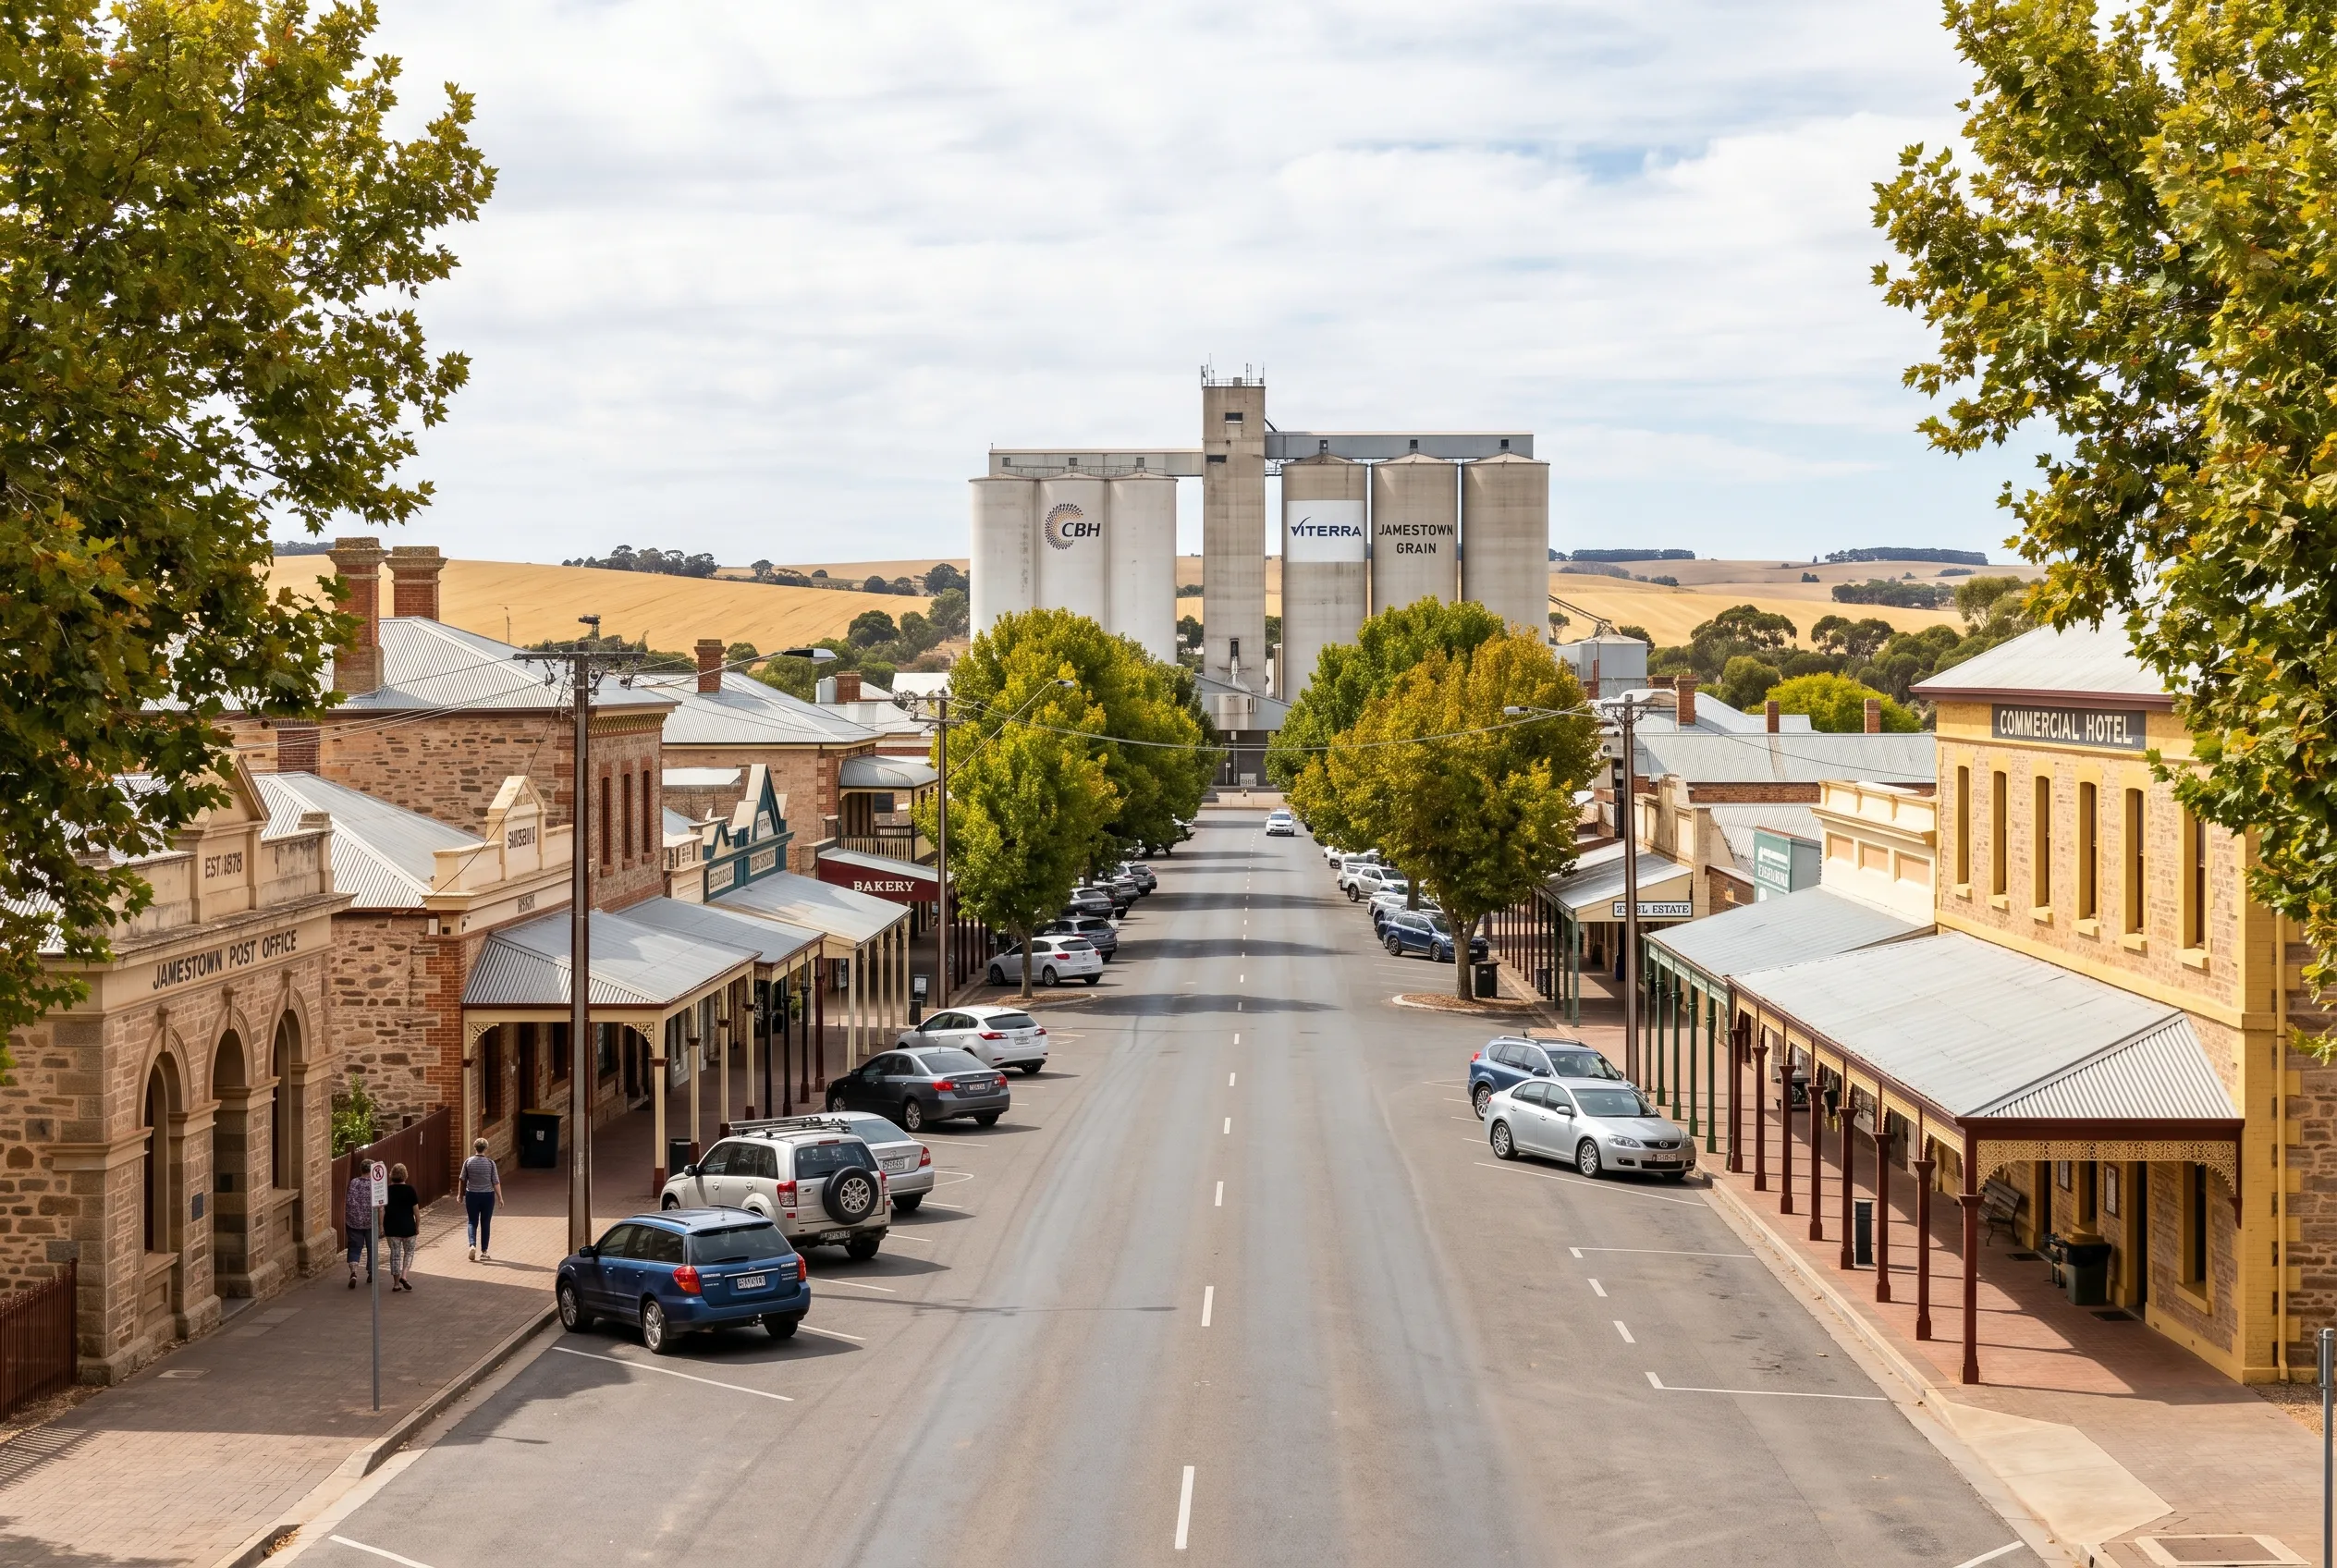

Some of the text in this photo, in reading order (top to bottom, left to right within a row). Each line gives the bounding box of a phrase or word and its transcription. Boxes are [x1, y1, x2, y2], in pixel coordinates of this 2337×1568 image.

[1061, 522, 1101, 537] CBH
[1291, 516, 1362, 537] VITERRA
[1378, 524, 1453, 536] JAMESTOWN
[1396, 543, 1437, 554] GRAIN
[2000, 710, 2134, 744] COMMERCIAL HOTEL
[853, 880, 915, 892] BAKERY
[1652, 904, 1689, 913] ESTATE
[153, 929, 297, 990] JAMESTOWN POST OFFICE
